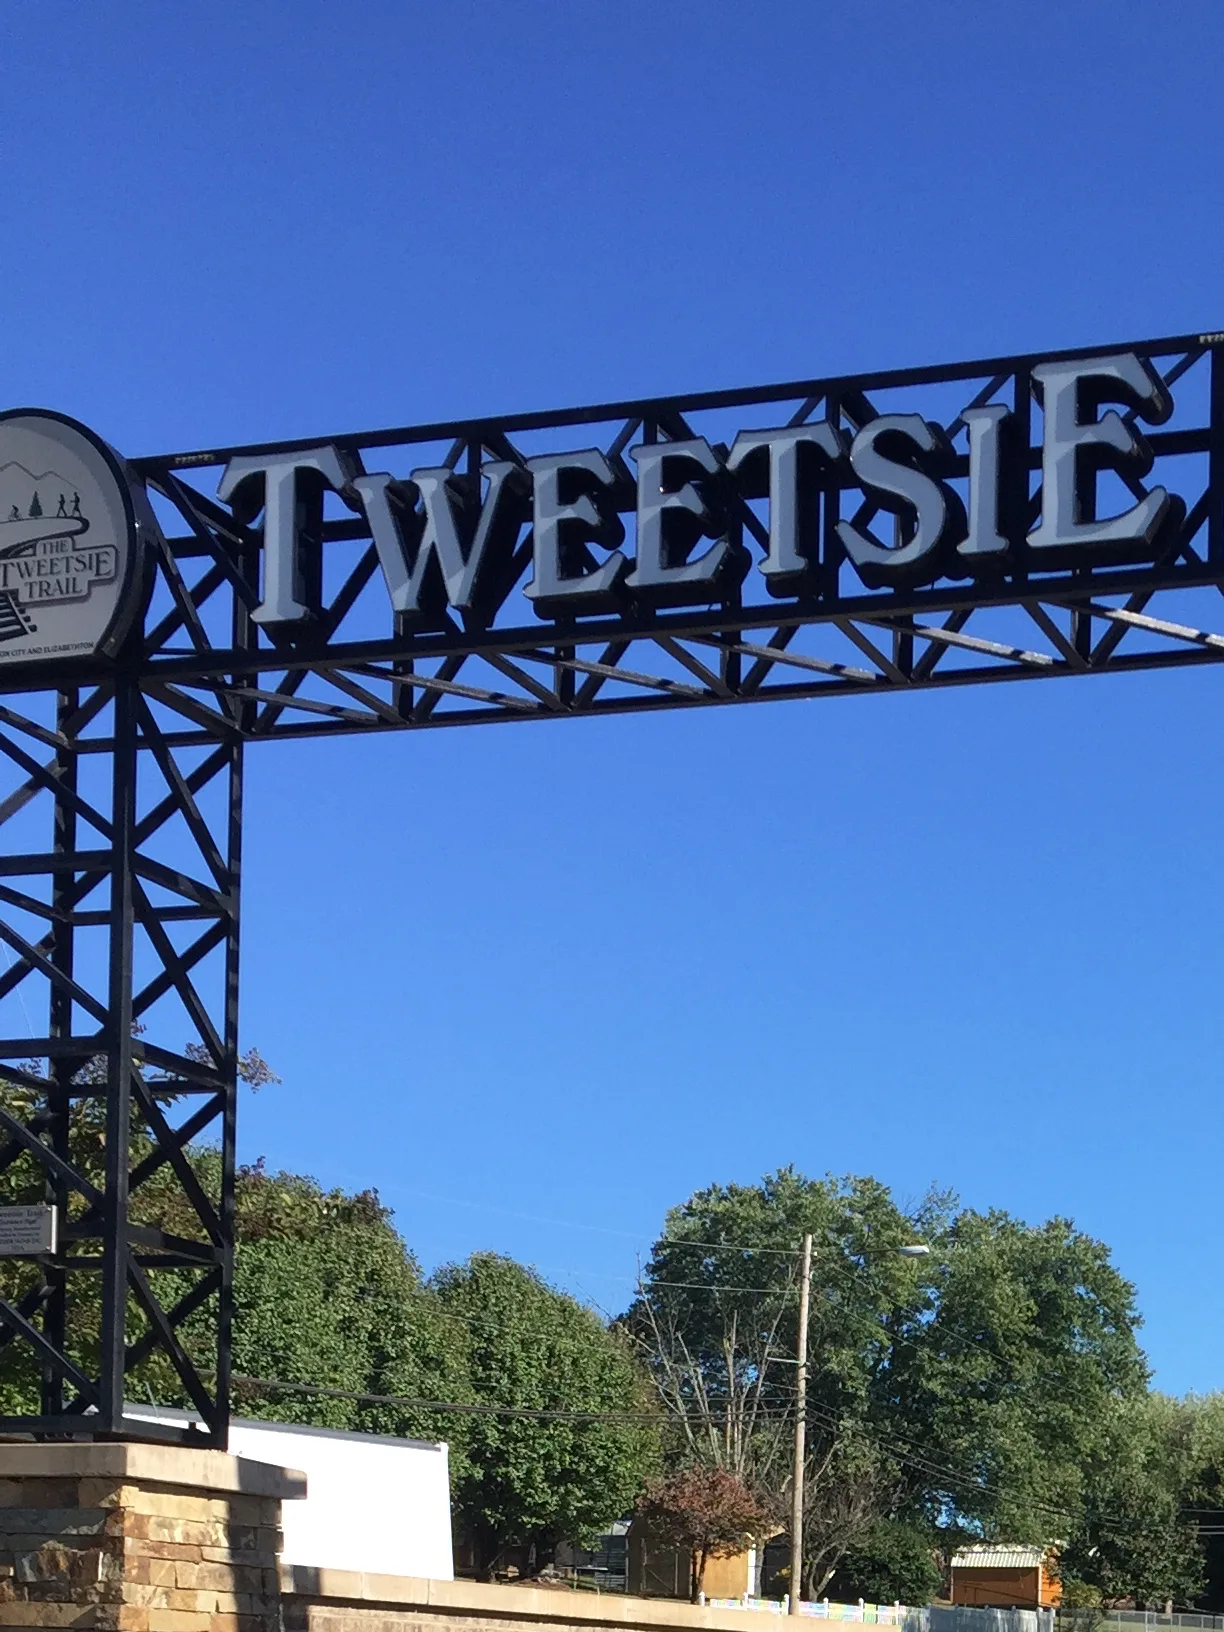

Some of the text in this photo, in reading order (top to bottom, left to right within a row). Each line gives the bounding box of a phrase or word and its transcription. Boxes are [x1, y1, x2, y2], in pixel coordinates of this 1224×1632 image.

[217, 352, 1174, 628] TWEETSIE
[42, 539, 69, 554] THE
[24, 577, 83, 598] TRAIL
[27, 646, 43, 655] AND
